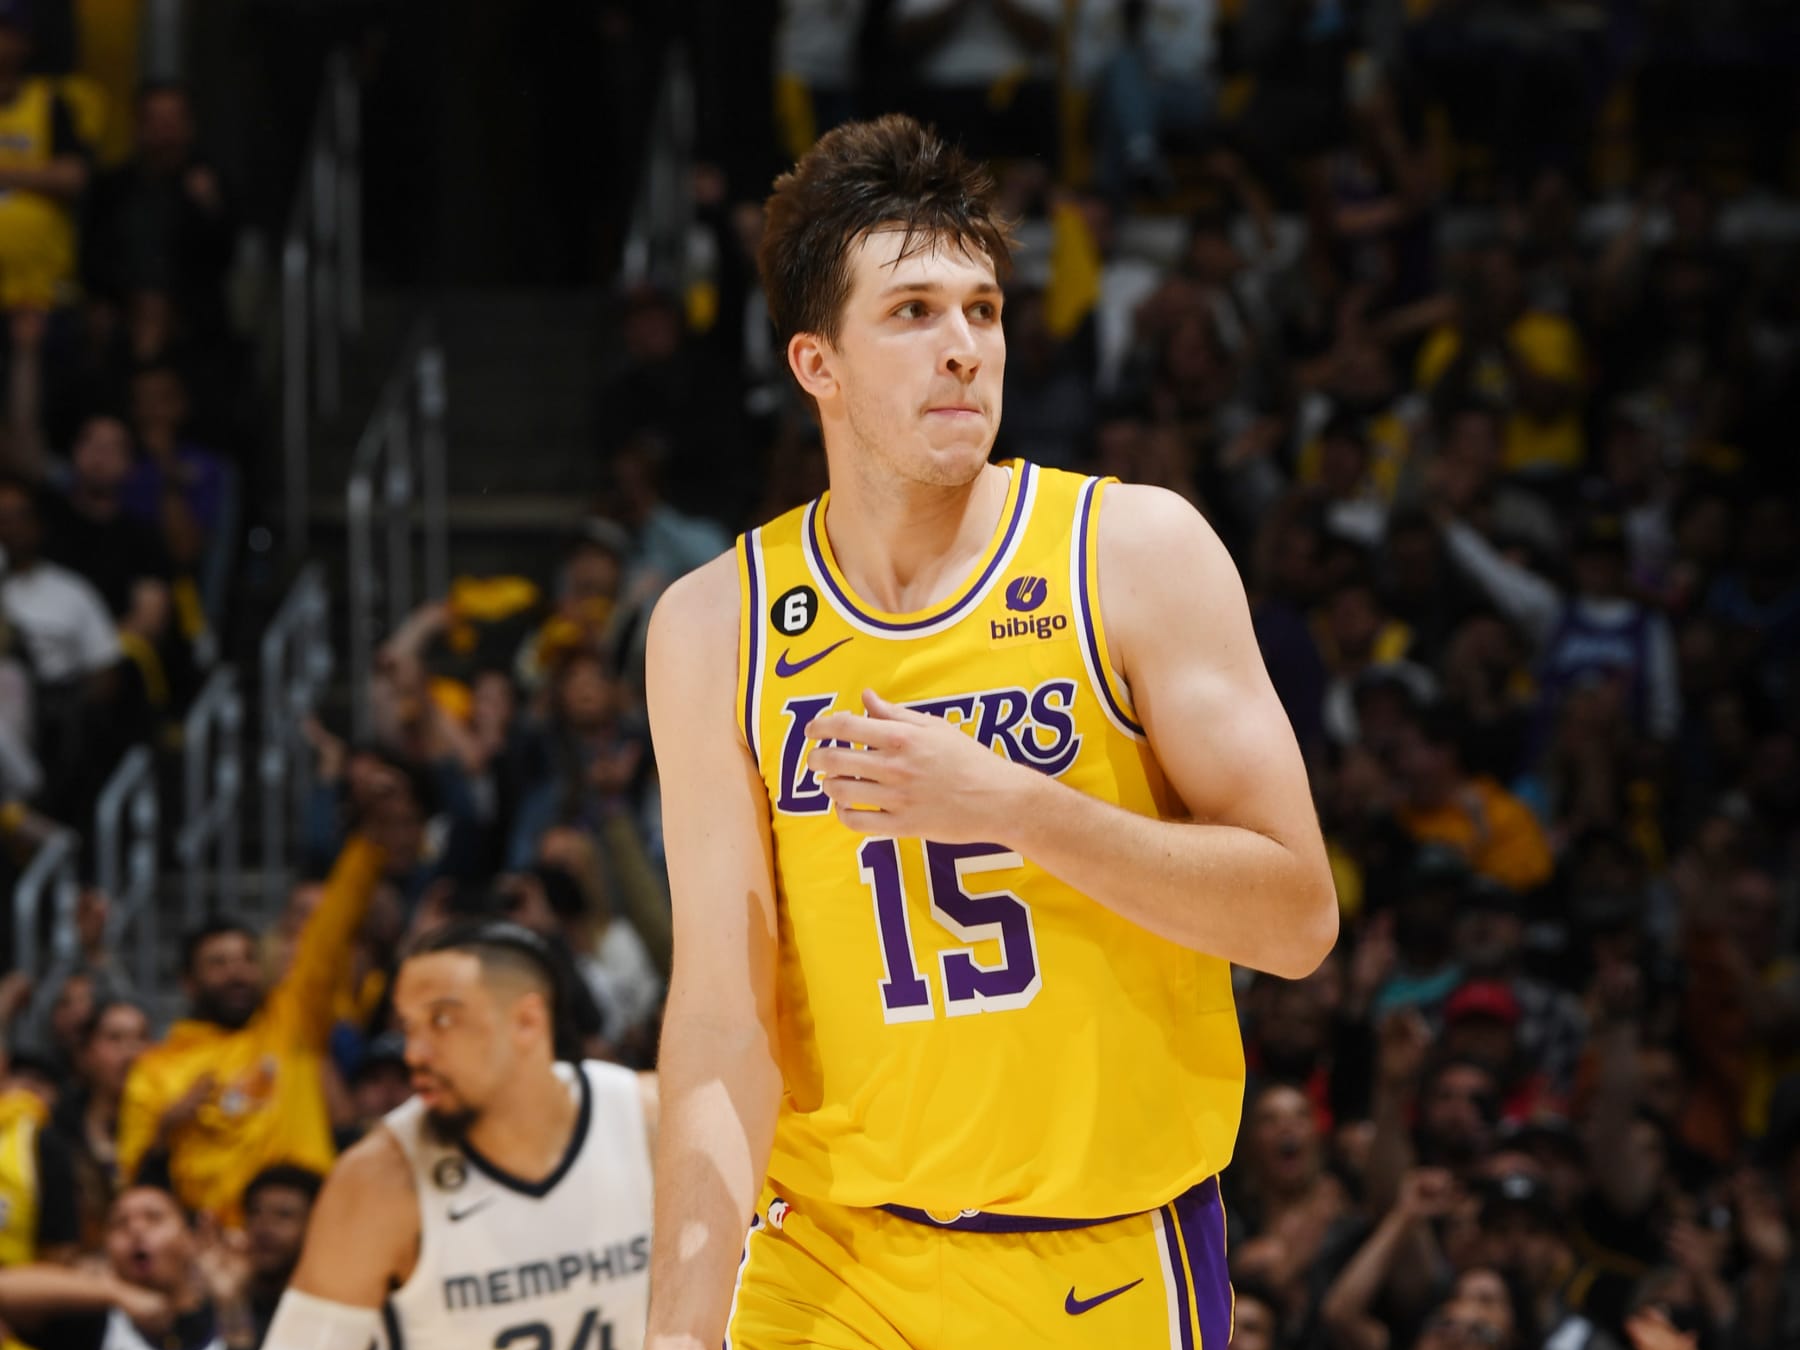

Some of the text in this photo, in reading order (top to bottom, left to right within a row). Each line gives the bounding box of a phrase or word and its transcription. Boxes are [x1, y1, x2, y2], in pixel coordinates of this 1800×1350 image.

[783, 591, 808, 631] 6
[990, 614, 1067, 639] bibigo
[856, 836, 1043, 1025] 15
[443, 1235, 649, 1311] MEMPHIS
